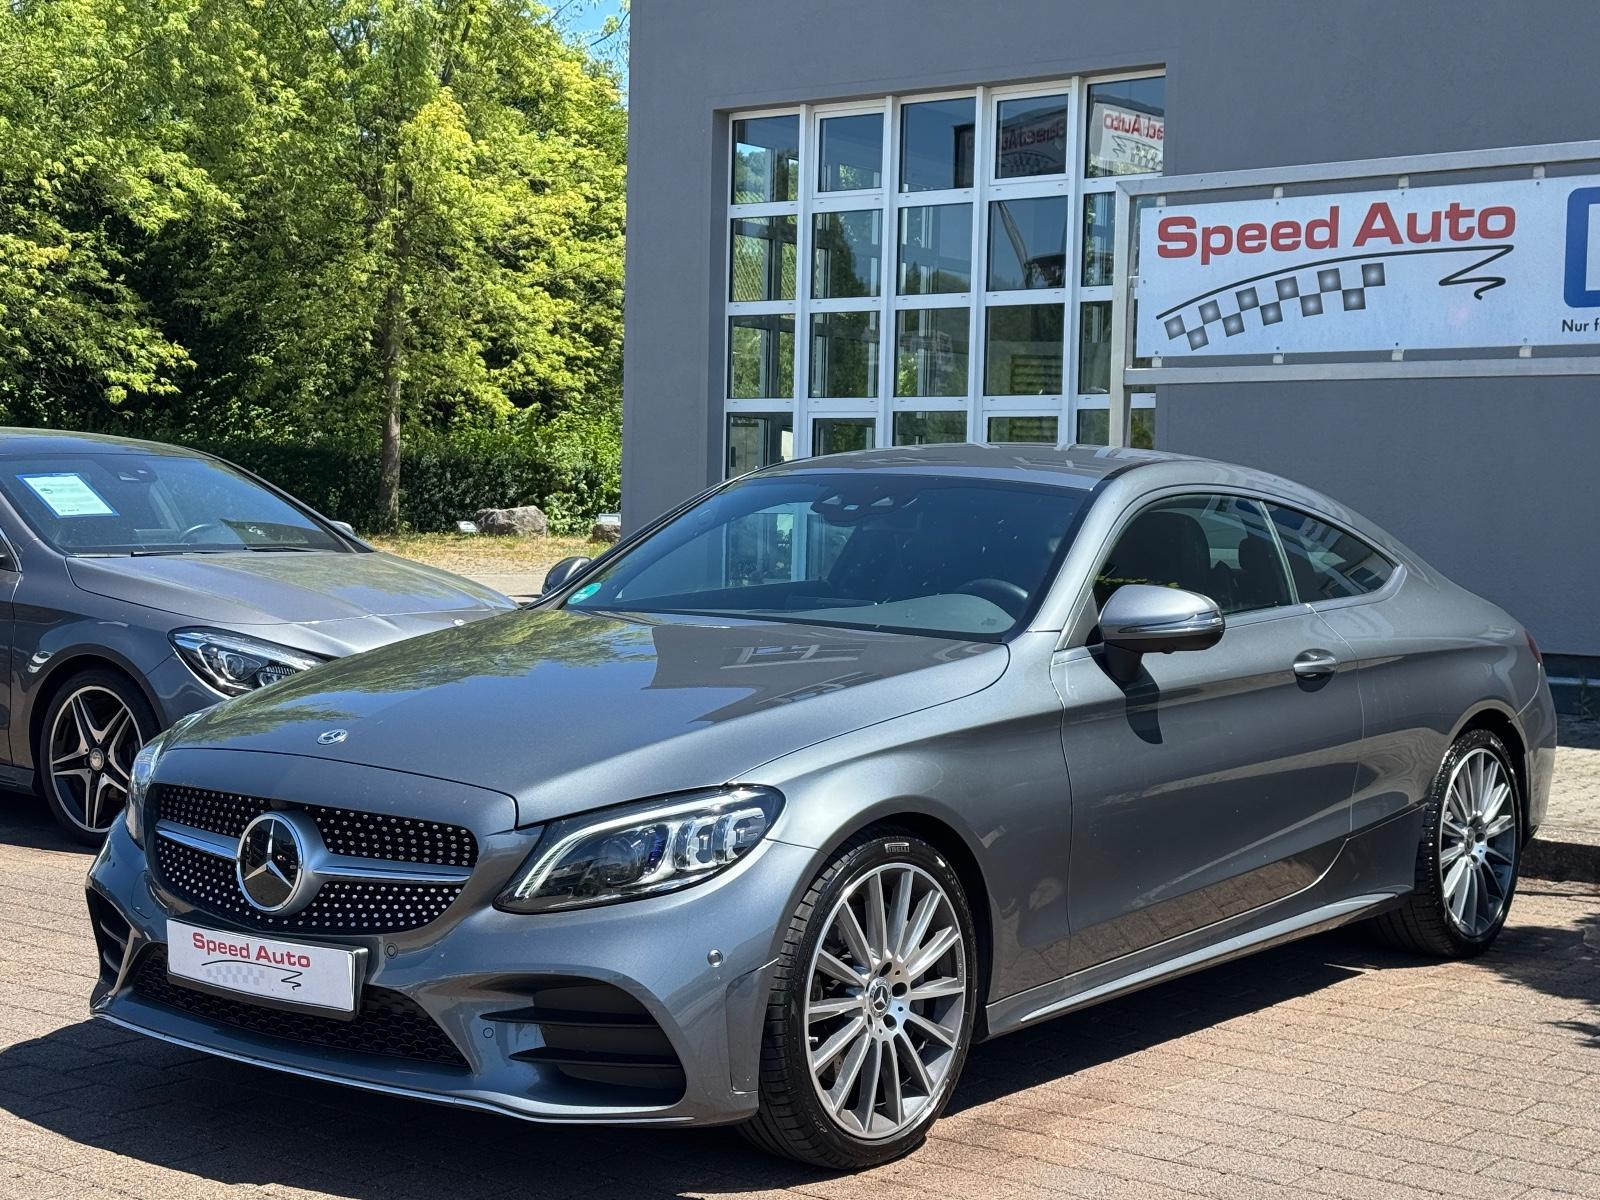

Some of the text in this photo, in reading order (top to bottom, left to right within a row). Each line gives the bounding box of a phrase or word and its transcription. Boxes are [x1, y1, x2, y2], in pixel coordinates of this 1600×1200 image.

[1157, 202, 1516, 266] Speed Auto
[1562, 318, 1590, 332] Nur
[192, 932, 311, 968] Speed Auto
